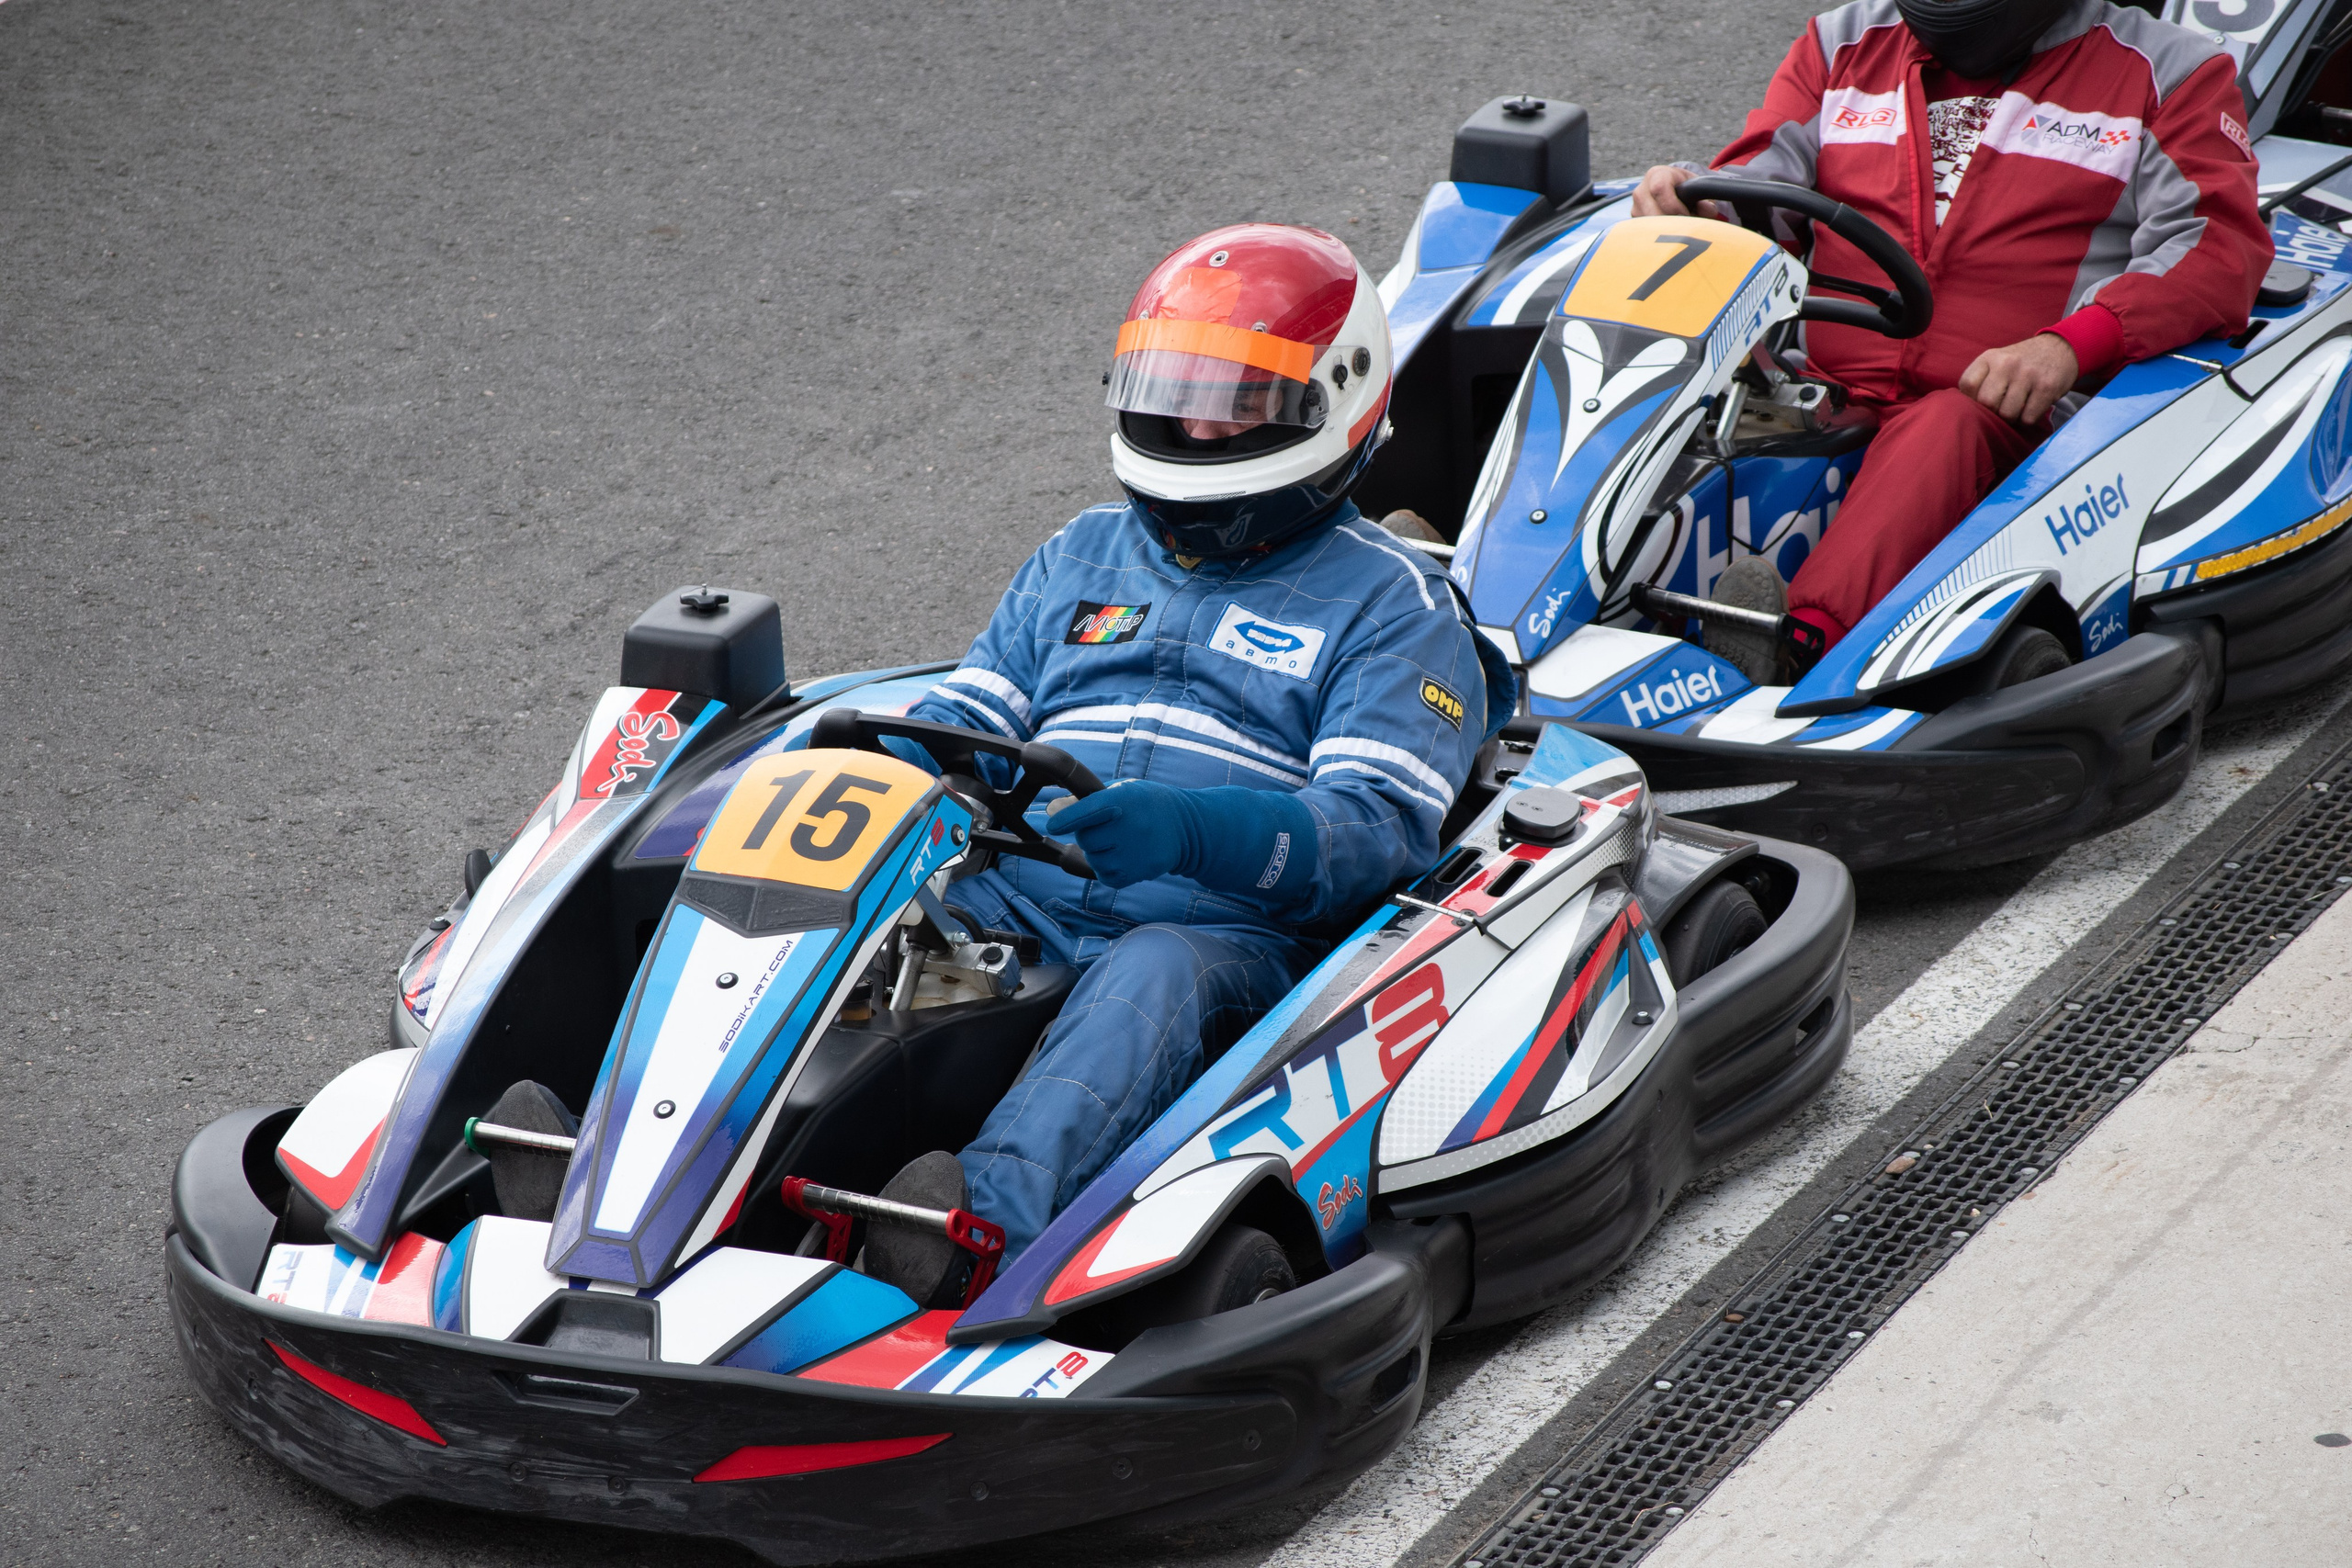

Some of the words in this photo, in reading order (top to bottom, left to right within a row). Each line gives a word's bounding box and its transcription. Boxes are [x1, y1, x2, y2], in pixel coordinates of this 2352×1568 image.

[1836, 110, 1891, 127] RLG
[2042, 133, 2117, 155] RACEWAY
[2047, 120, 2101, 141] ADM
[1626, 234, 1713, 301] 7
[2044, 472, 2130, 556] Haier
[1529, 588, 1571, 638] Sodi
[2088, 613, 2124, 653] Sodi
[1425, 684, 1464, 718] OMP
[1620, 664, 1723, 728] Haier
[596, 711, 681, 792] Sodi
[741, 769, 893, 862] 15
[910, 817, 944, 886] RT8
[1207, 962, 1451, 1162] RT8
[1317, 1174, 1363, 1231] Sodi
